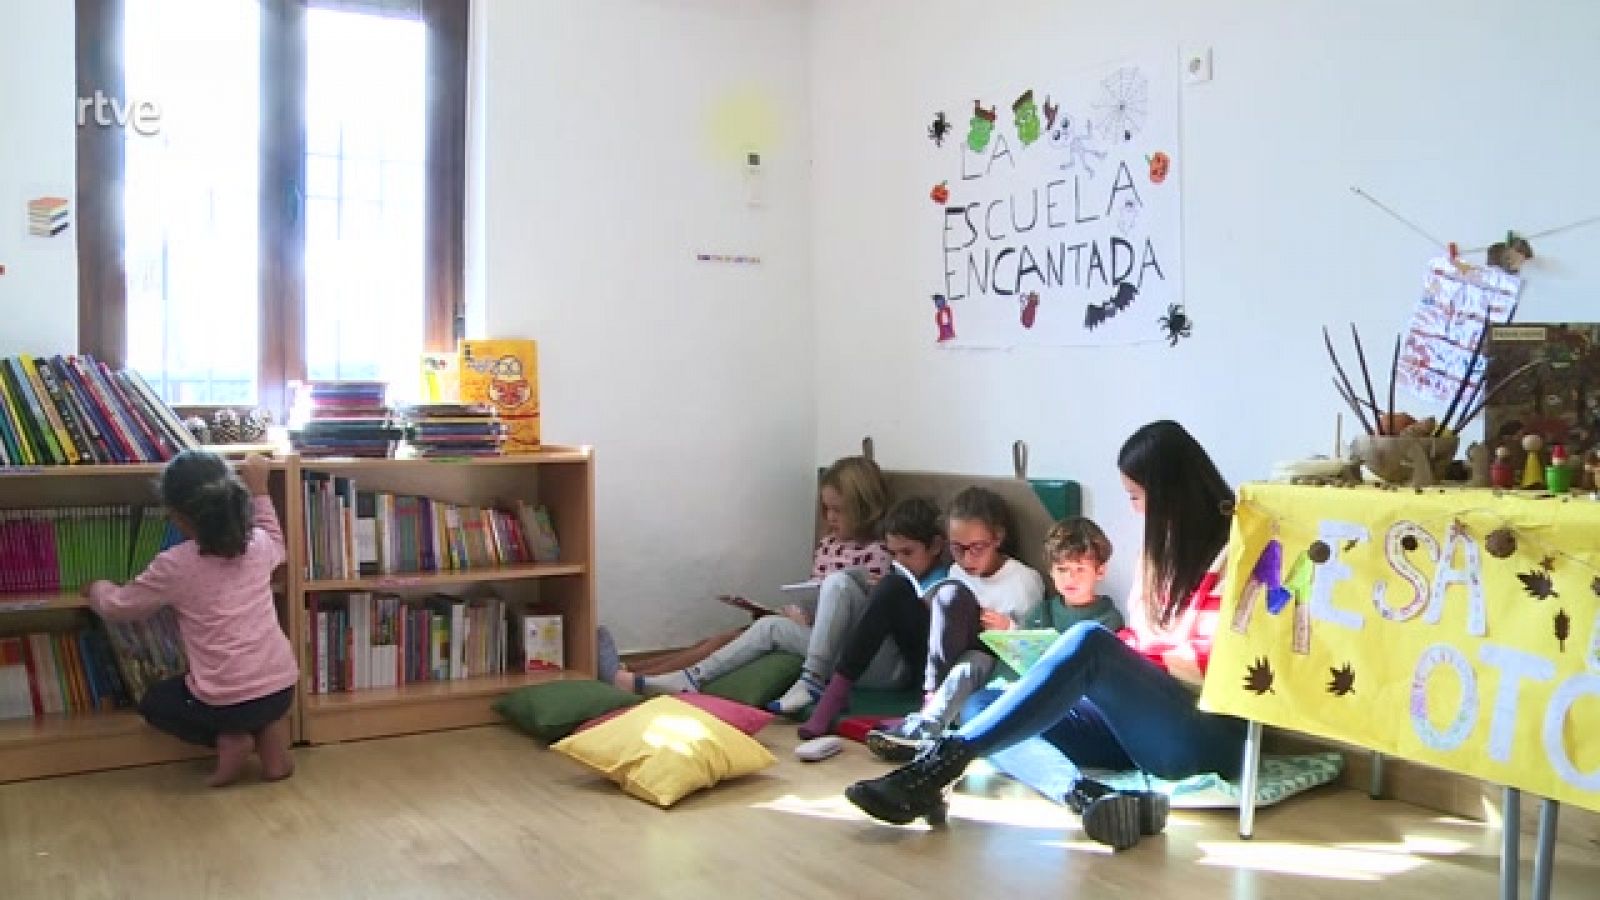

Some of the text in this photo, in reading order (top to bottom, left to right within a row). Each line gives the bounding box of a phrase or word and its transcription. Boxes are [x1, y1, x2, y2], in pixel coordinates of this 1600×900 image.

[960, 134, 1016, 181] LA
[943, 160, 1143, 251] ESCUELA
[944, 236, 1166, 301] ENCANTADA
[1231, 518, 1488, 656] MESA
